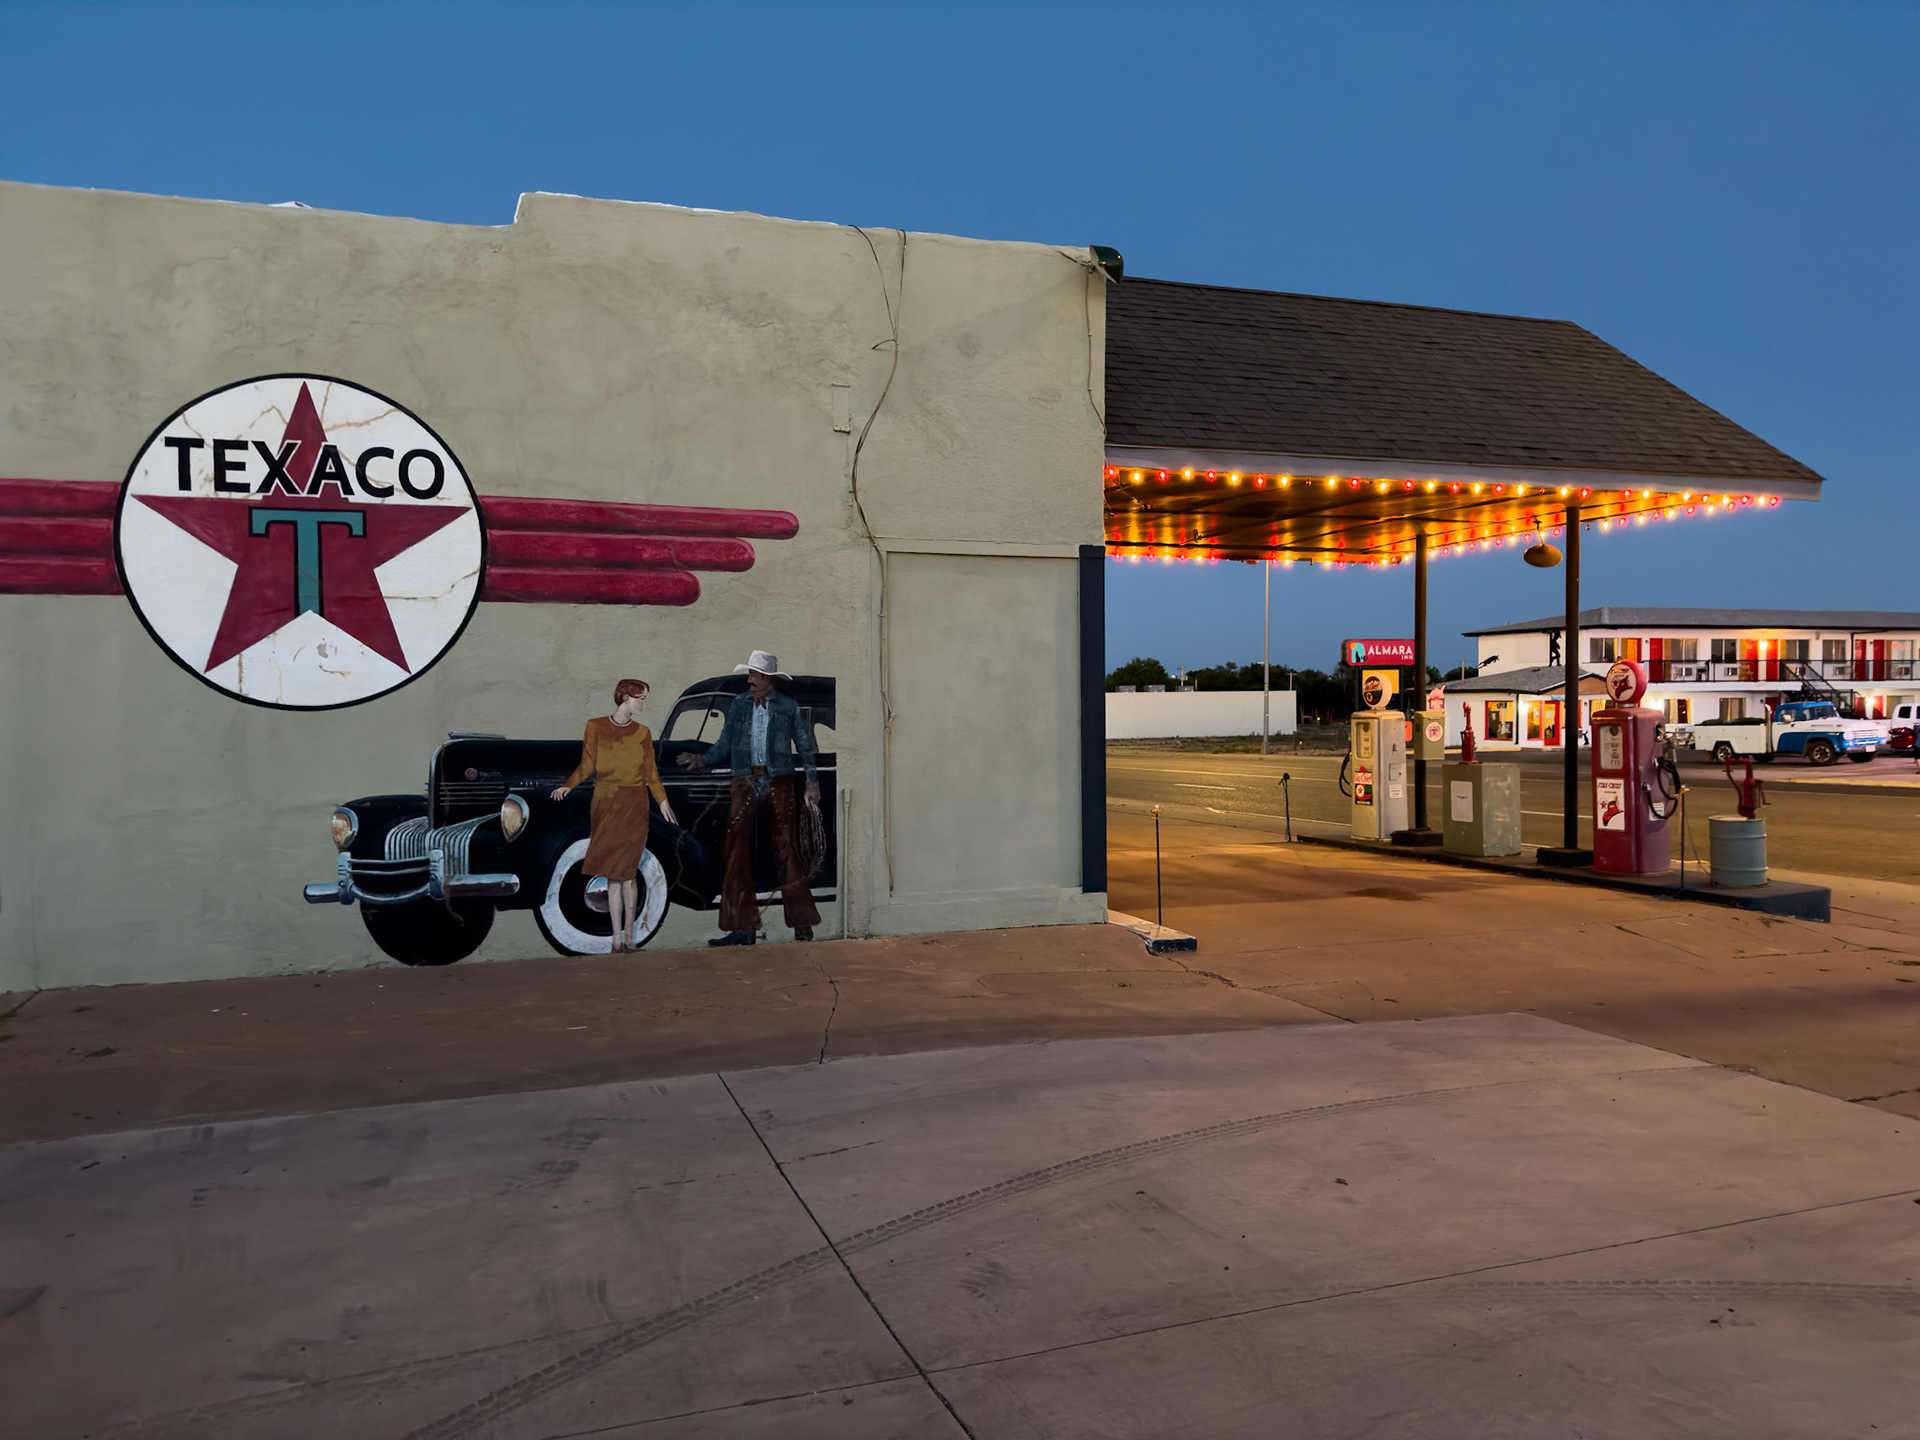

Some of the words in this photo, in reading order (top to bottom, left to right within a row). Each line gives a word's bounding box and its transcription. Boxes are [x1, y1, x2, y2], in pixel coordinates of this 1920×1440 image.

[164, 436, 445, 500] TEXACO
[248, 506, 367, 619] T
[1368, 645, 1413, 655] ALMARA
